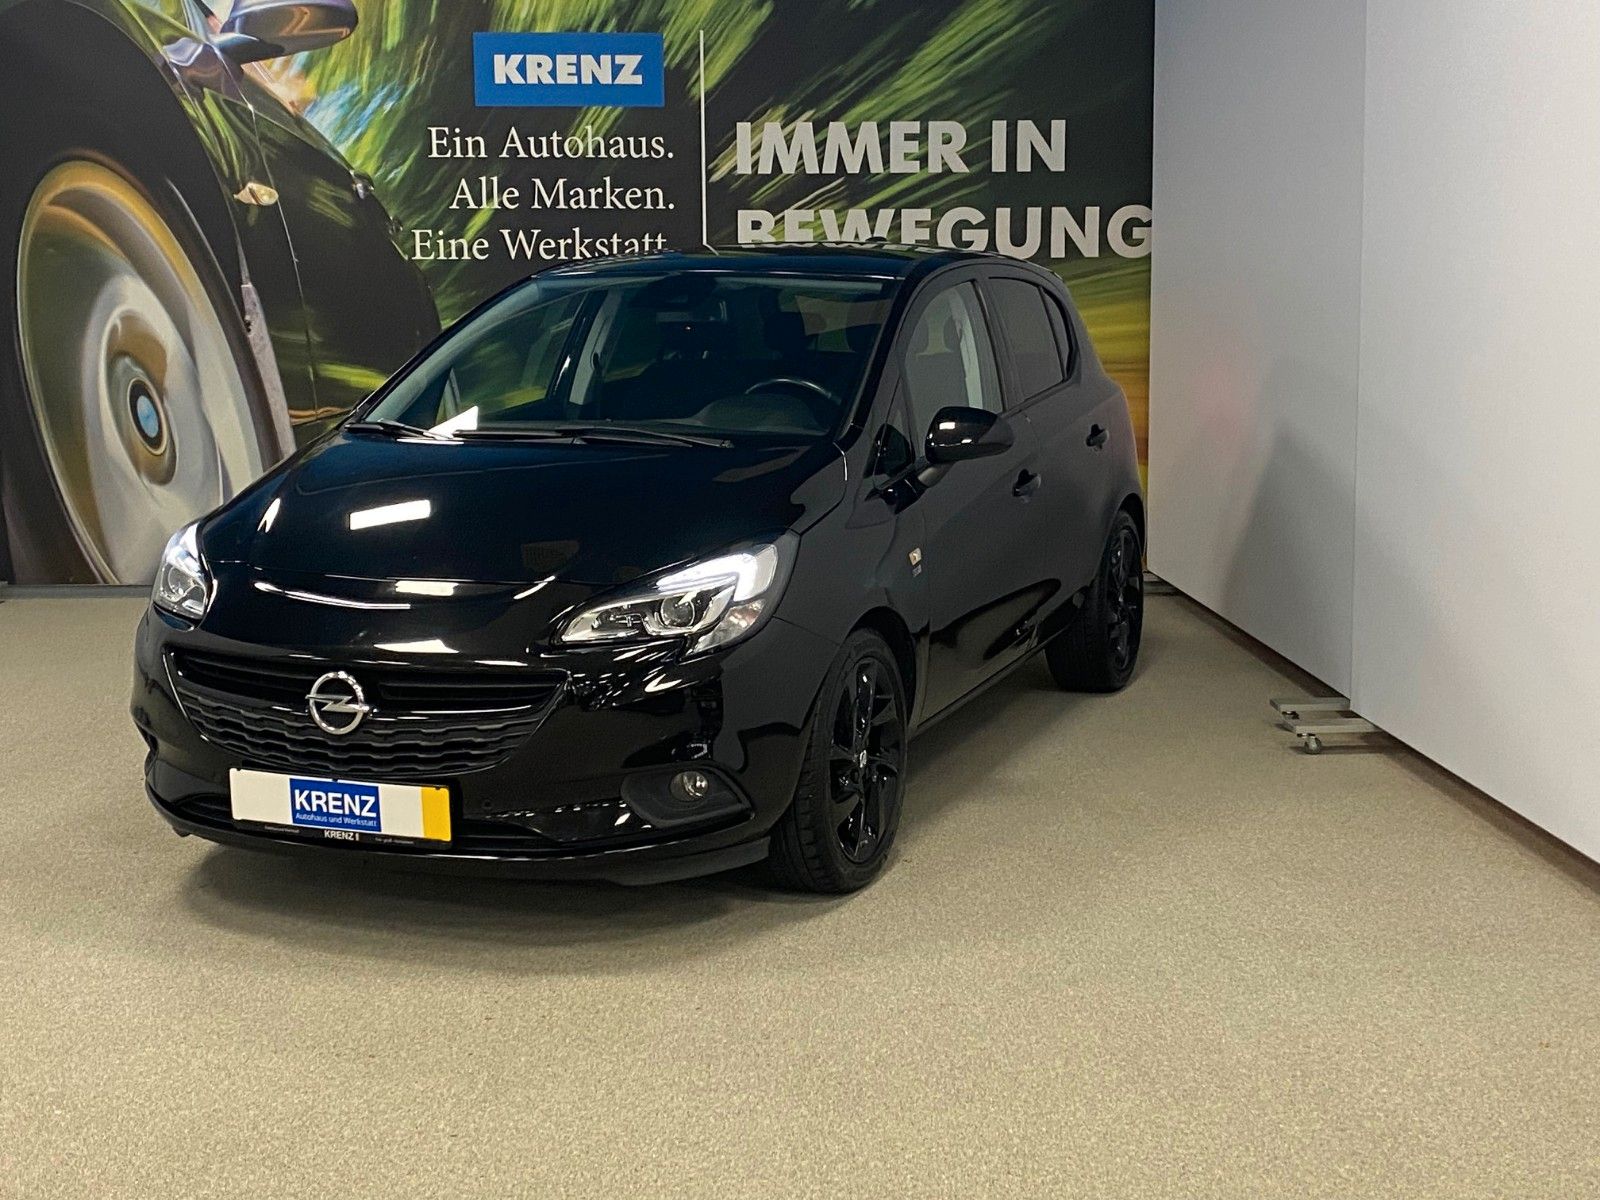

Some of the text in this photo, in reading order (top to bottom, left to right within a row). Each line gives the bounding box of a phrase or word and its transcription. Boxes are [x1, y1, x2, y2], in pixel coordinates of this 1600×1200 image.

[494, 54, 643, 85] KRENZ
[427, 126, 674, 159] Ein Autohaus.
[736, 119, 1066, 175] IMMER IN
[449, 176, 675, 209] Alle Marken.
[411, 229, 489, 260] Eine
[737, 206, 1152, 259] BEWEGUNG
[294, 789, 377, 818] KRENZ
[295, 812, 377, 827] Autohaus und Werkstatt
[324, 829, 354, 841] KRENZ
